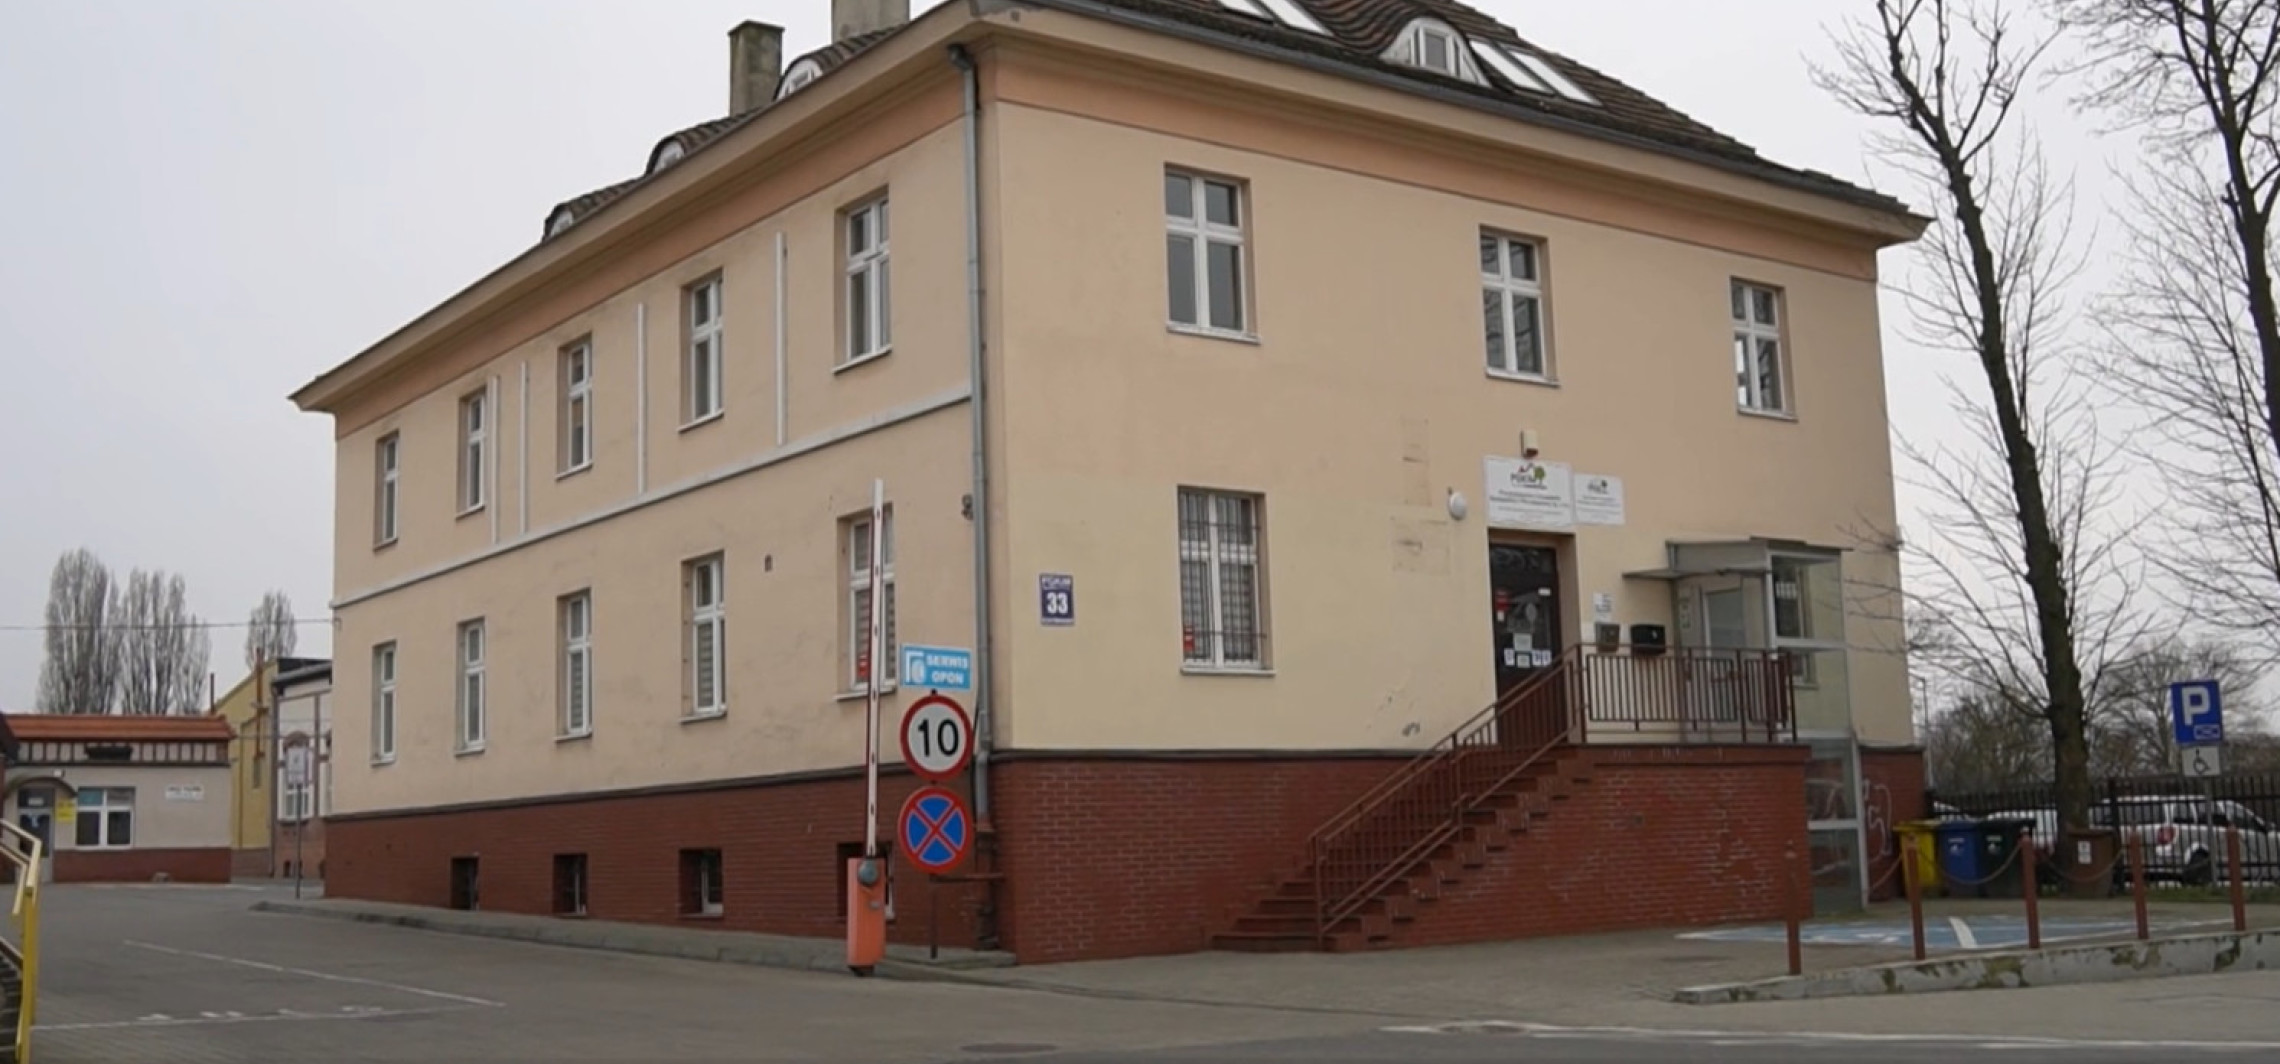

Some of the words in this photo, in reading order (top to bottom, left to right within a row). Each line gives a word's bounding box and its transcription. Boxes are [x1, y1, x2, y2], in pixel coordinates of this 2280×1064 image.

[1047, 592, 1069, 614] 33
[926, 653, 968, 669] SERWIS
[932, 670, 964, 685] OPON
[2181, 686, 2211, 726] P
[918, 718, 959, 757] 10
